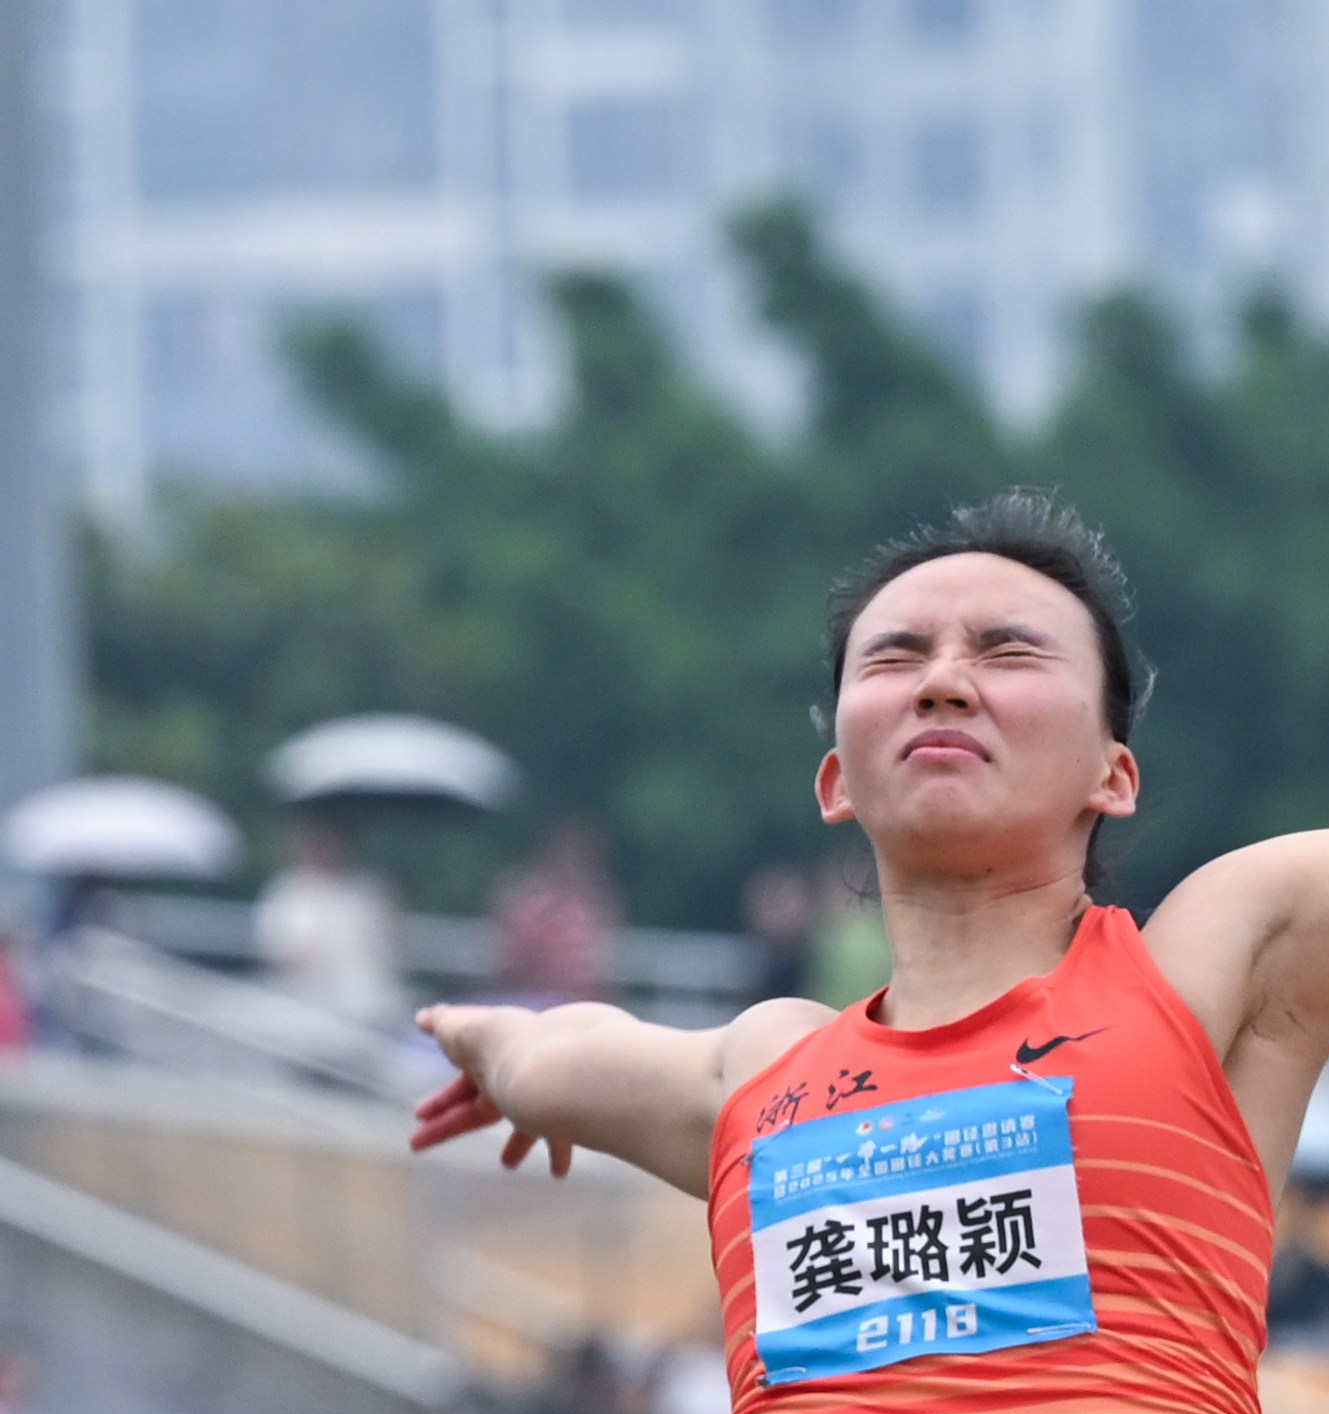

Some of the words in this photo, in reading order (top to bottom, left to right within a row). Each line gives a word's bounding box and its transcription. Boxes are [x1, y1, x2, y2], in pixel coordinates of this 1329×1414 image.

[756, 1069, 877, 1133] 浙江
[786, 1189, 1042, 1312] 龚璐颖
[857, 1304, 978, 1352] 2118
